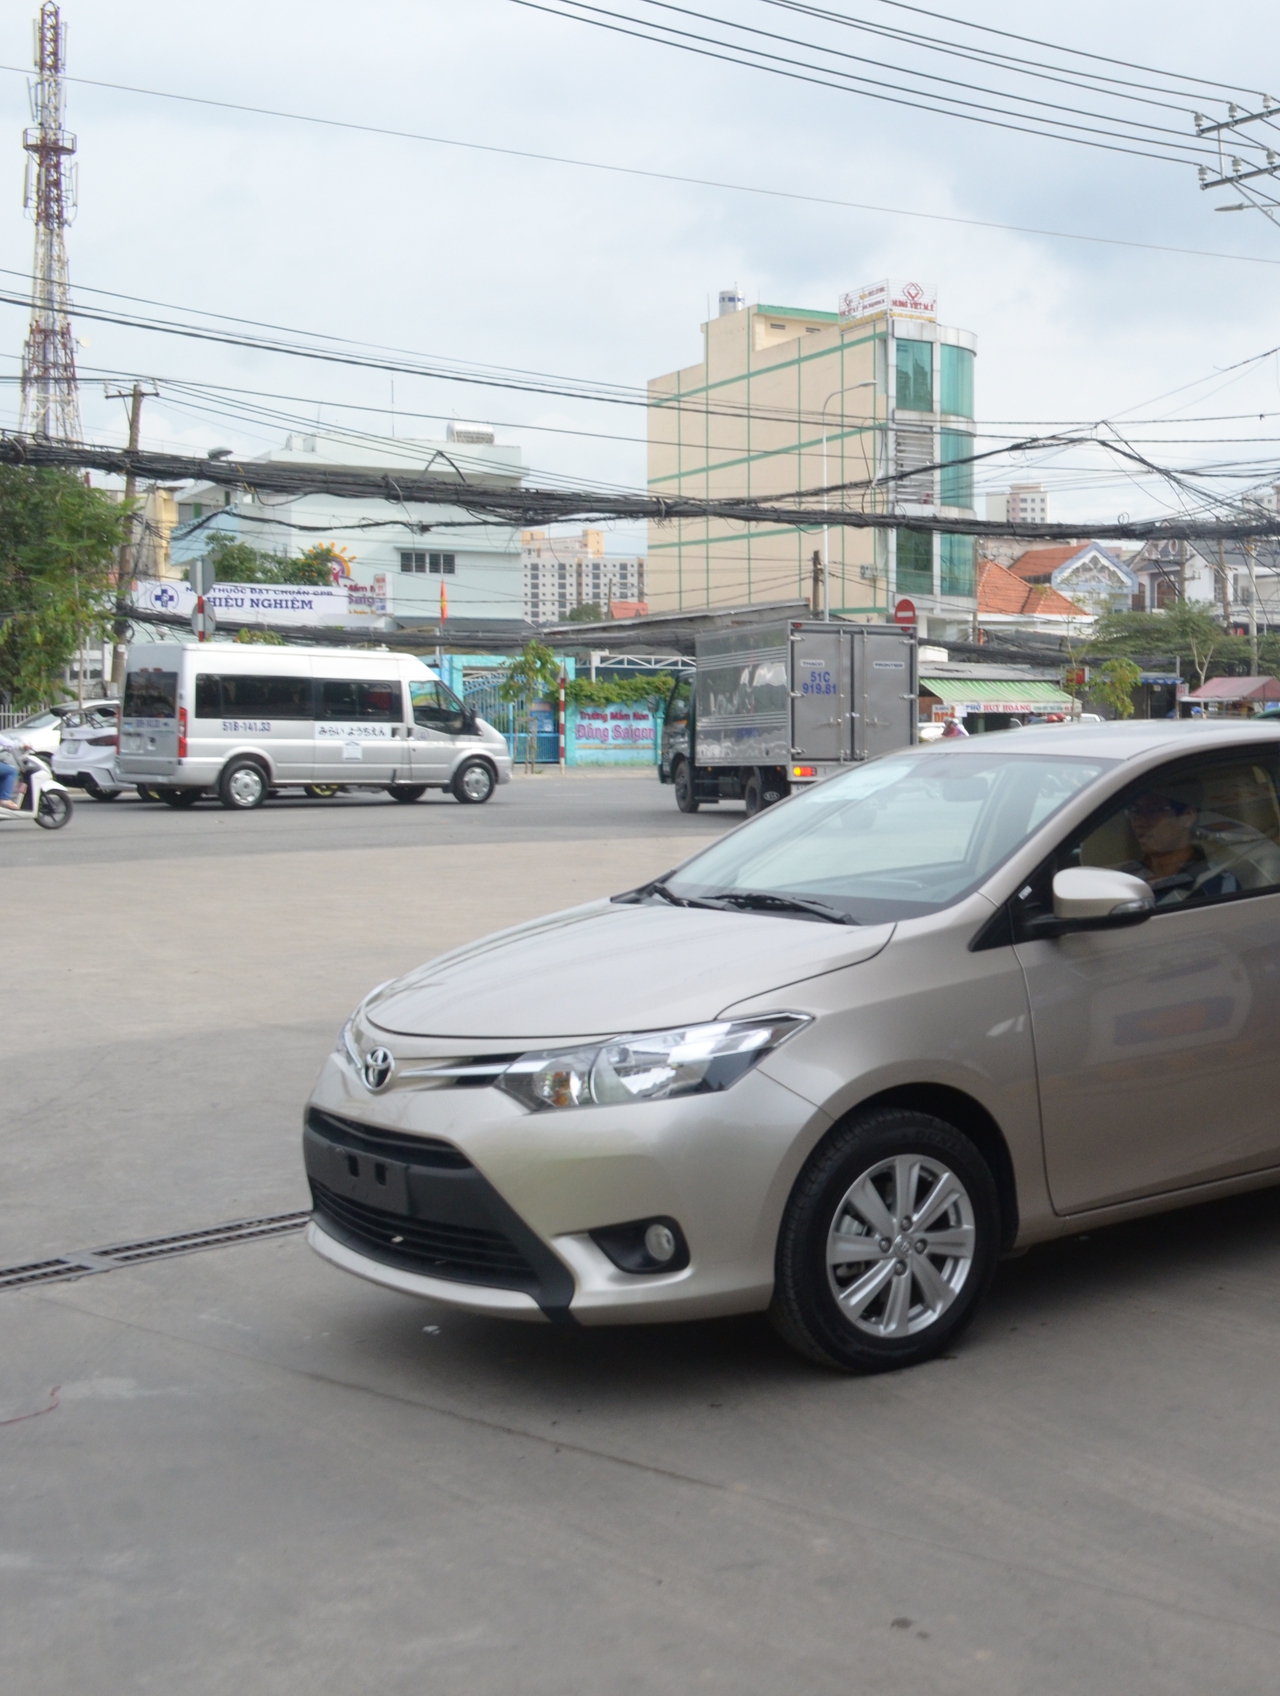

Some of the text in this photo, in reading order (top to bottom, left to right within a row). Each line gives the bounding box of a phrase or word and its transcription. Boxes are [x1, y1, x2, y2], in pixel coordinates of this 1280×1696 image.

[250, 596, 314, 612] NGHIỆM
[810, 671, 831, 683] 51C
[612, 723, 655, 743] Saigon
